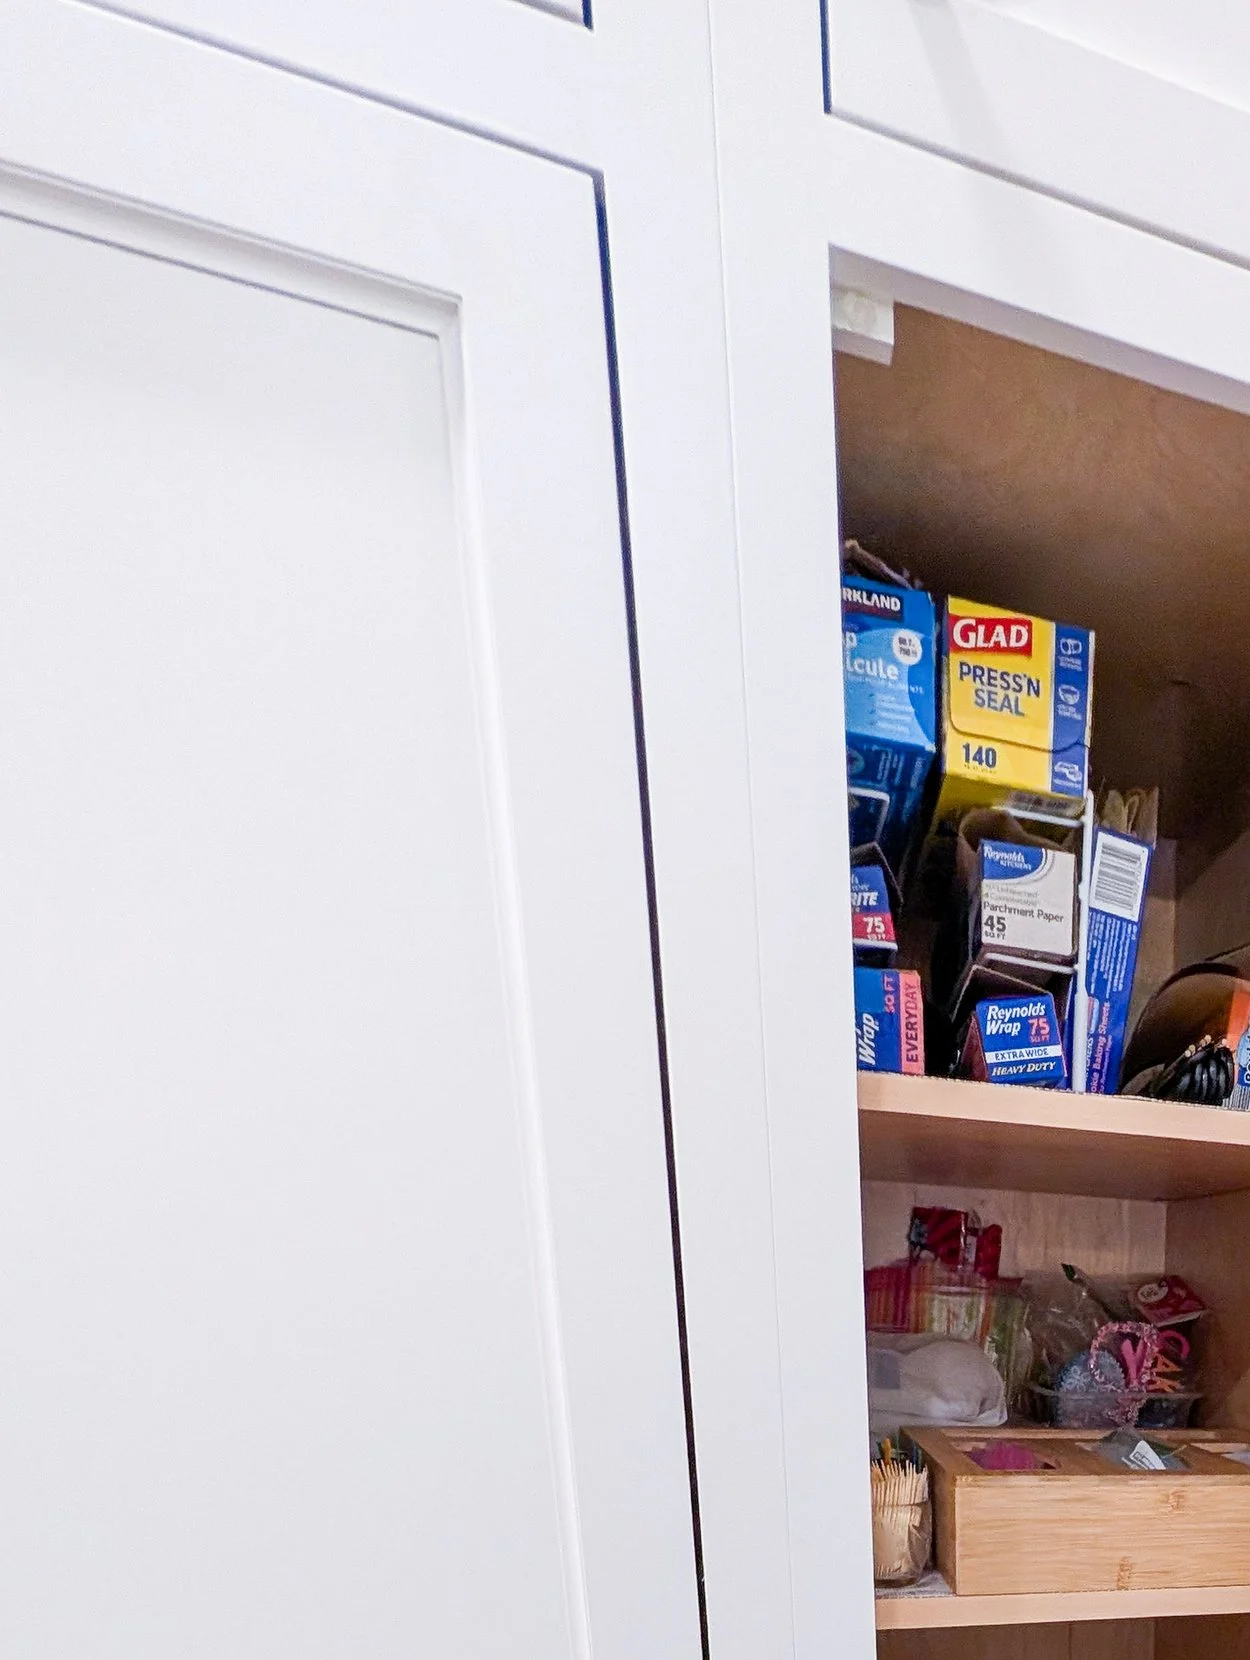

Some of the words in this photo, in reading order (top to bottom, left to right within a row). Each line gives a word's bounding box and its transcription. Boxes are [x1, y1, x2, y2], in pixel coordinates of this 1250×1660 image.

[841, 587, 901, 612] RKLAND
[953, 618, 1029, 649] GLAD
[959, 661, 1041, 698] PRESS'N
[974, 688, 1025, 717] SEAL
[962, 742, 998, 769] 140
[851, 891, 879, 906] RITE
[983, 901, 1035, 918] Parchment
[1037, 909, 1064, 923] Paper
[984, 915, 1007, 932] 45
[863, 916, 886, 933] 75
[904, 982, 919, 1063] EVERYDAY
[986, 1003, 1046, 1022] Reynolds
[1098, 1001, 1110, 1034] Sheets
[986, 1020, 1021, 1037] Wrap
[1028, 1017, 1050, 1036] 75
[857, 1013, 880, 1066] Wrap
[994, 1051, 1024, 1061] EXTRA
[1025, 1047, 1049, 1058] WIDE
[1093, 1036, 1107, 1070] Baking
[991, 1064, 1026, 1076] HEAVY
[1026, 1061, 1056, 1073] DUTY
[1091, 1072, 1100, 1092] okie
